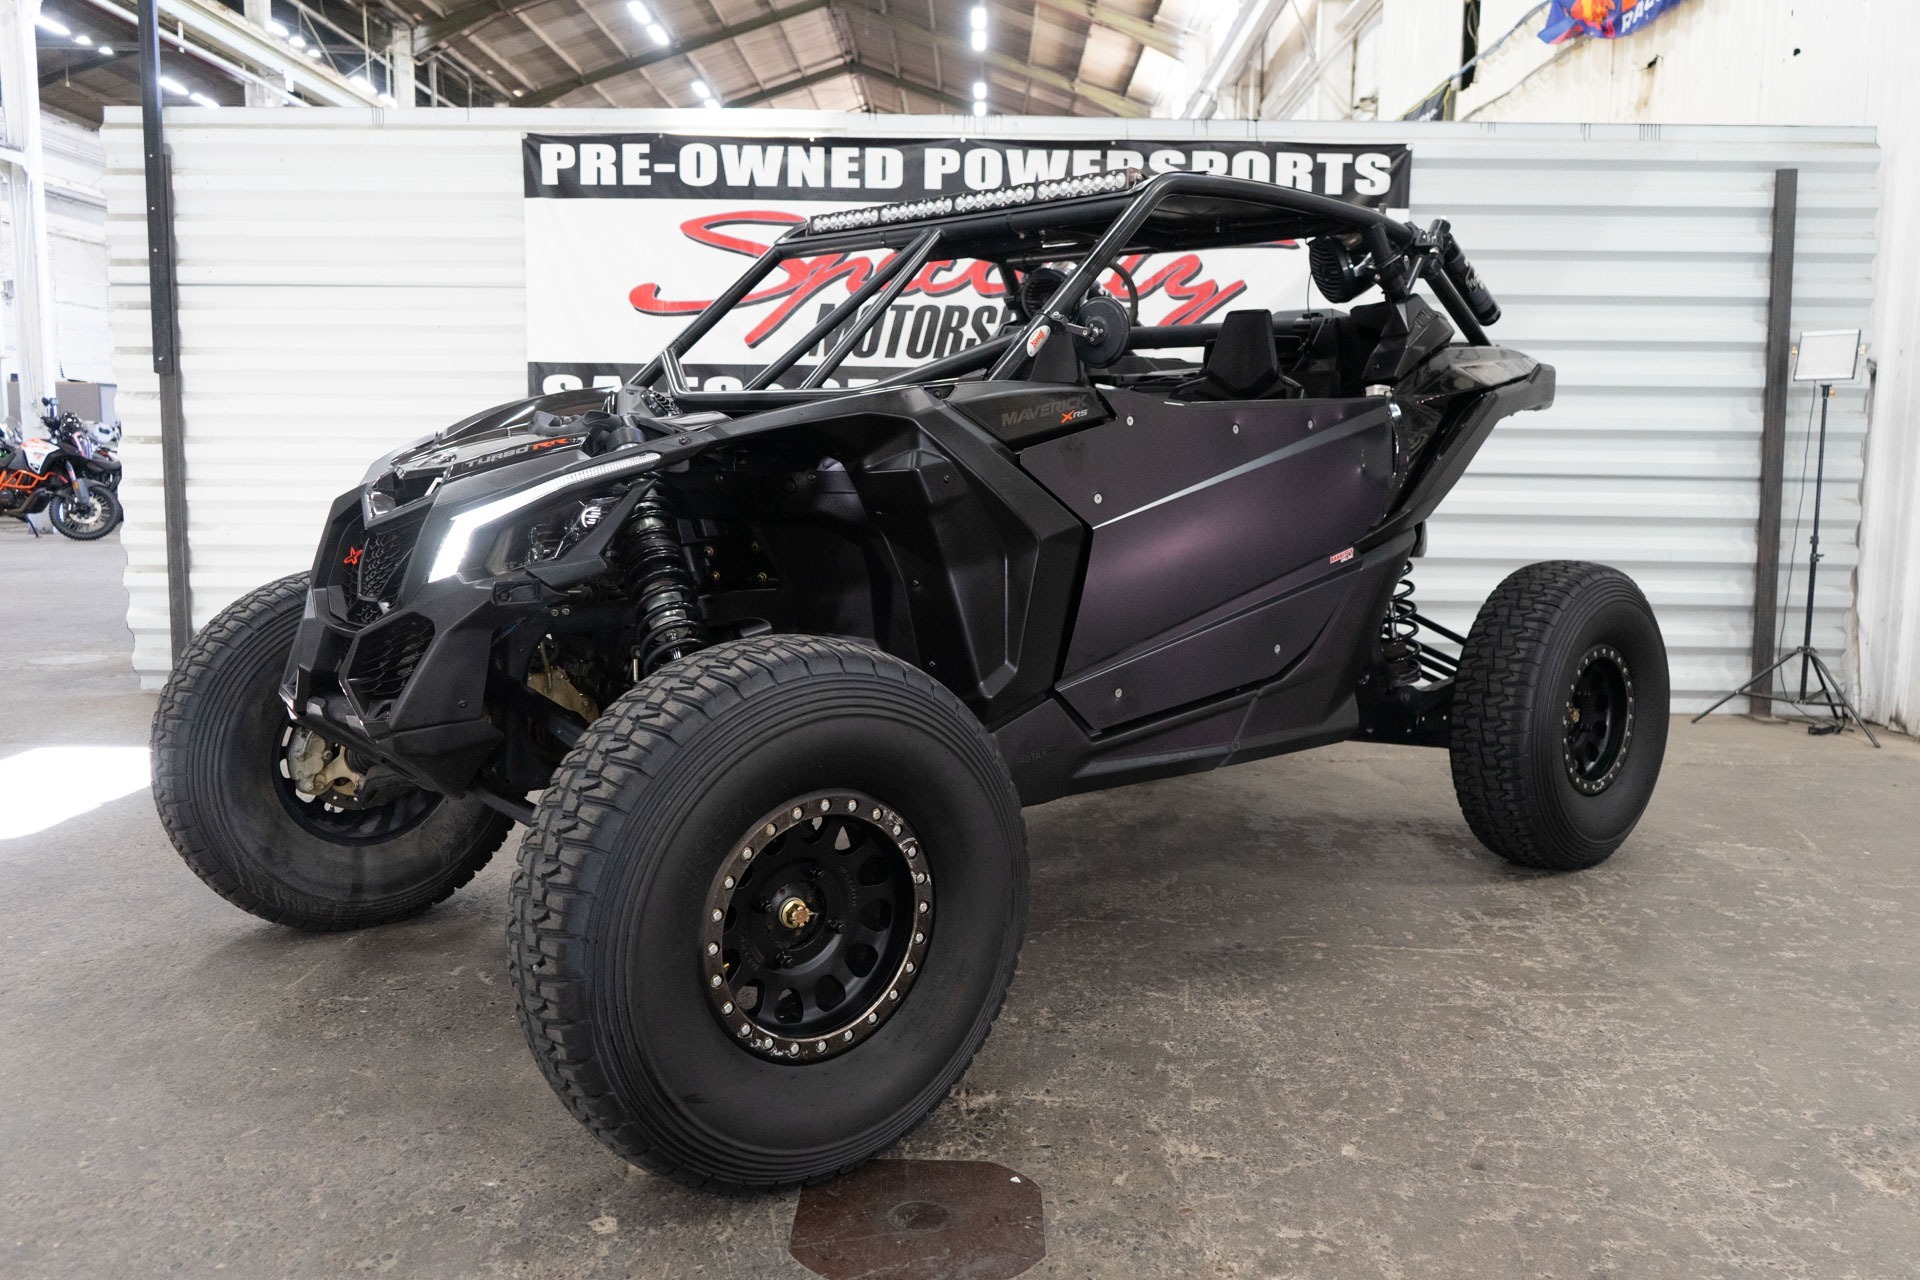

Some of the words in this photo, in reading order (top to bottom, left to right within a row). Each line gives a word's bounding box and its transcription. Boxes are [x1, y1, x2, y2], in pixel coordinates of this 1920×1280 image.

[539, 143, 904, 190] PRE-OWNED
[1002, 396, 1088, 426] MAVERICK
[466, 445, 530, 468] TURBO
[532, 437, 568, 451] RR
